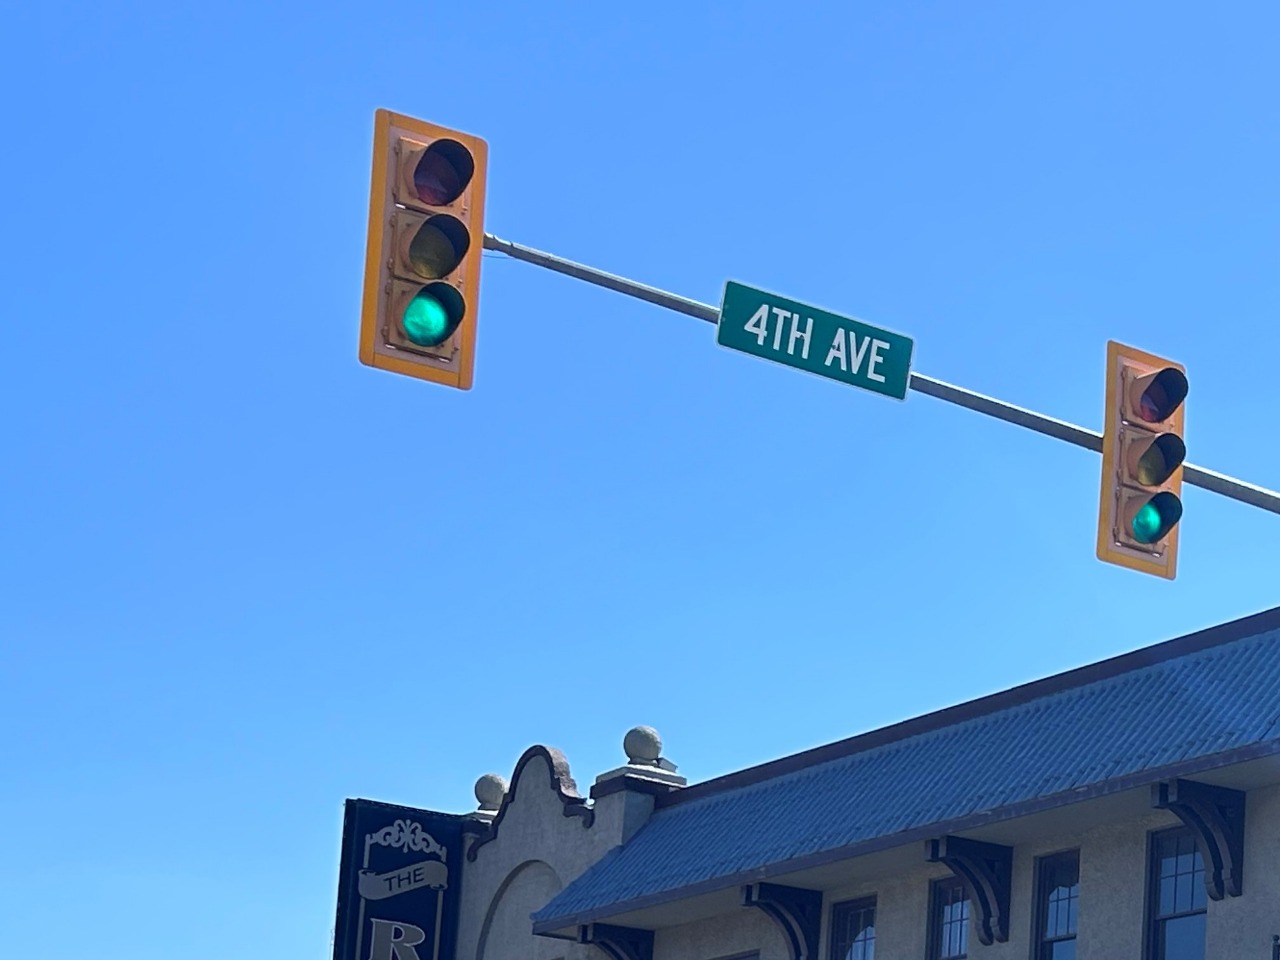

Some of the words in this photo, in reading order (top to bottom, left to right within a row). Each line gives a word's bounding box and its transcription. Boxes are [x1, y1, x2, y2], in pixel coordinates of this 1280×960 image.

[743, 304, 814, 360] 4TH
[824, 327, 891, 383] AVE
[382, 866, 426, 892] THE
